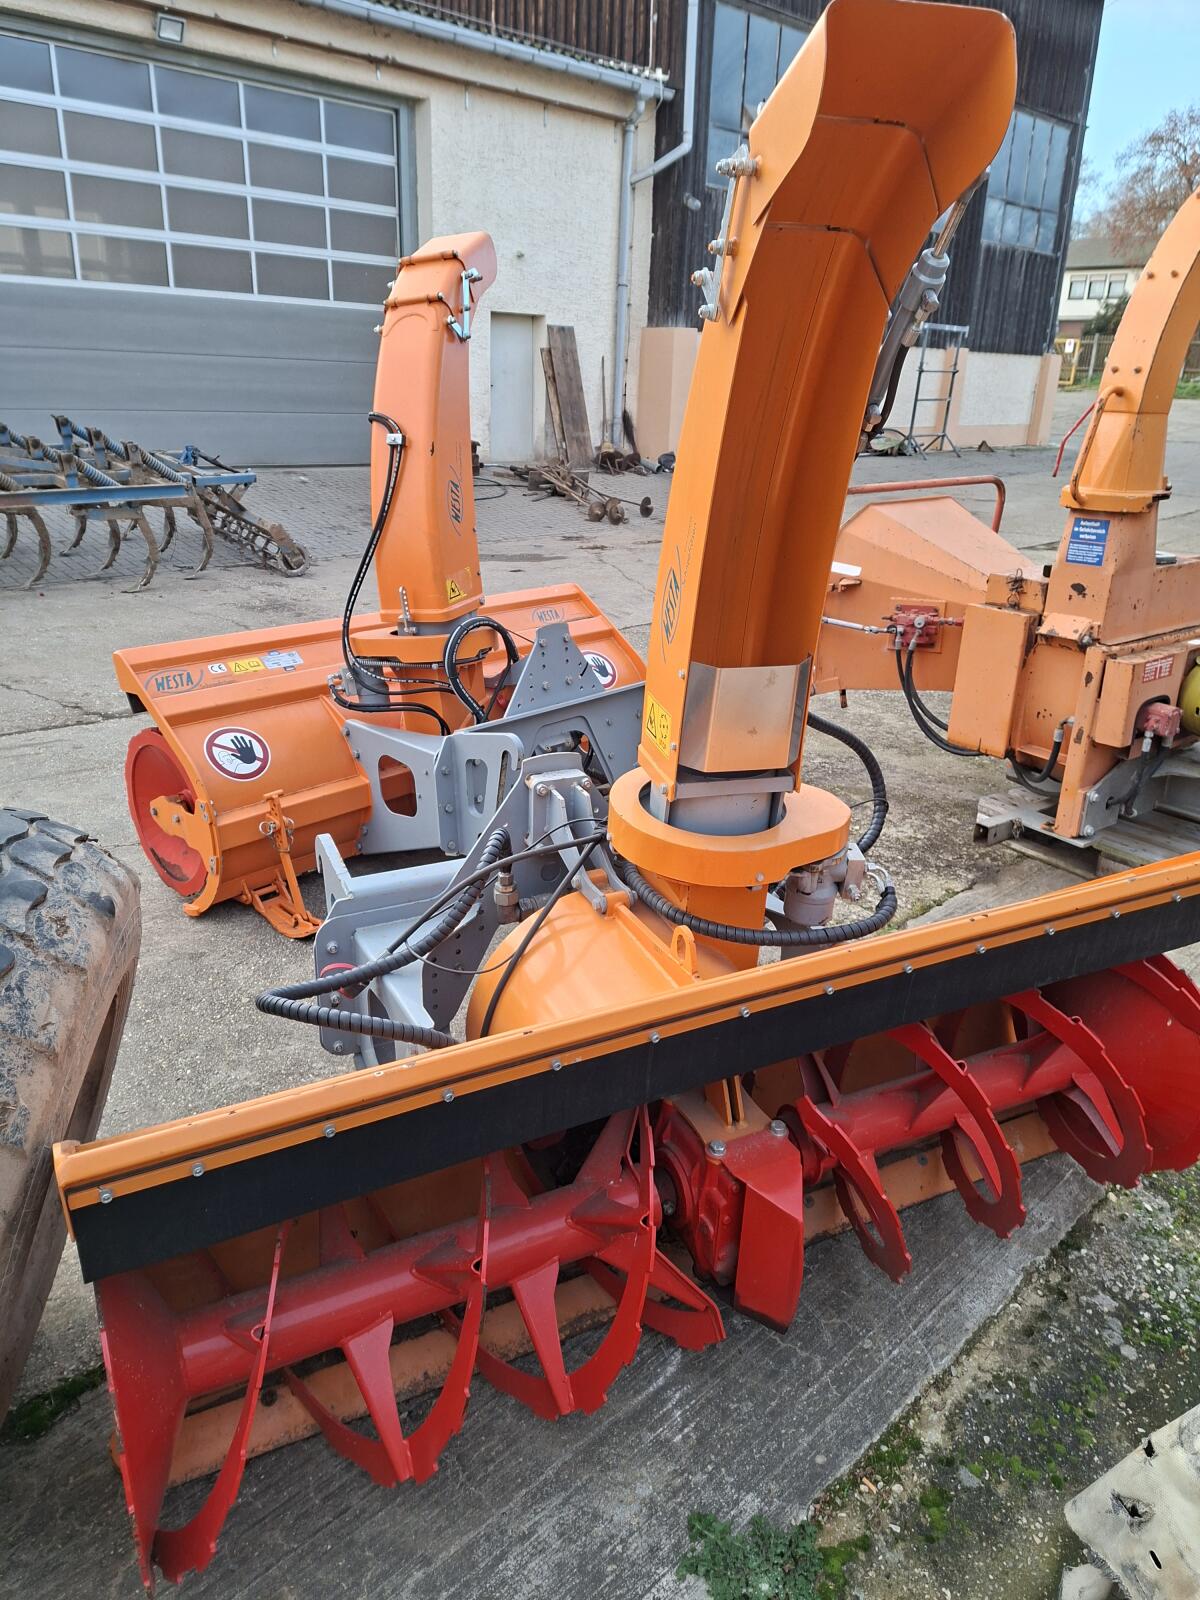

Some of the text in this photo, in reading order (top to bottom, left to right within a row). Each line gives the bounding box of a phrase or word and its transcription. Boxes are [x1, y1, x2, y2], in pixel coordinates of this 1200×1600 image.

[449, 479, 461, 524] WESTA
[536, 609, 560, 622] WESTA
[663, 569, 680, 645] WESTA
[154, 671, 194, 692] WESTA
